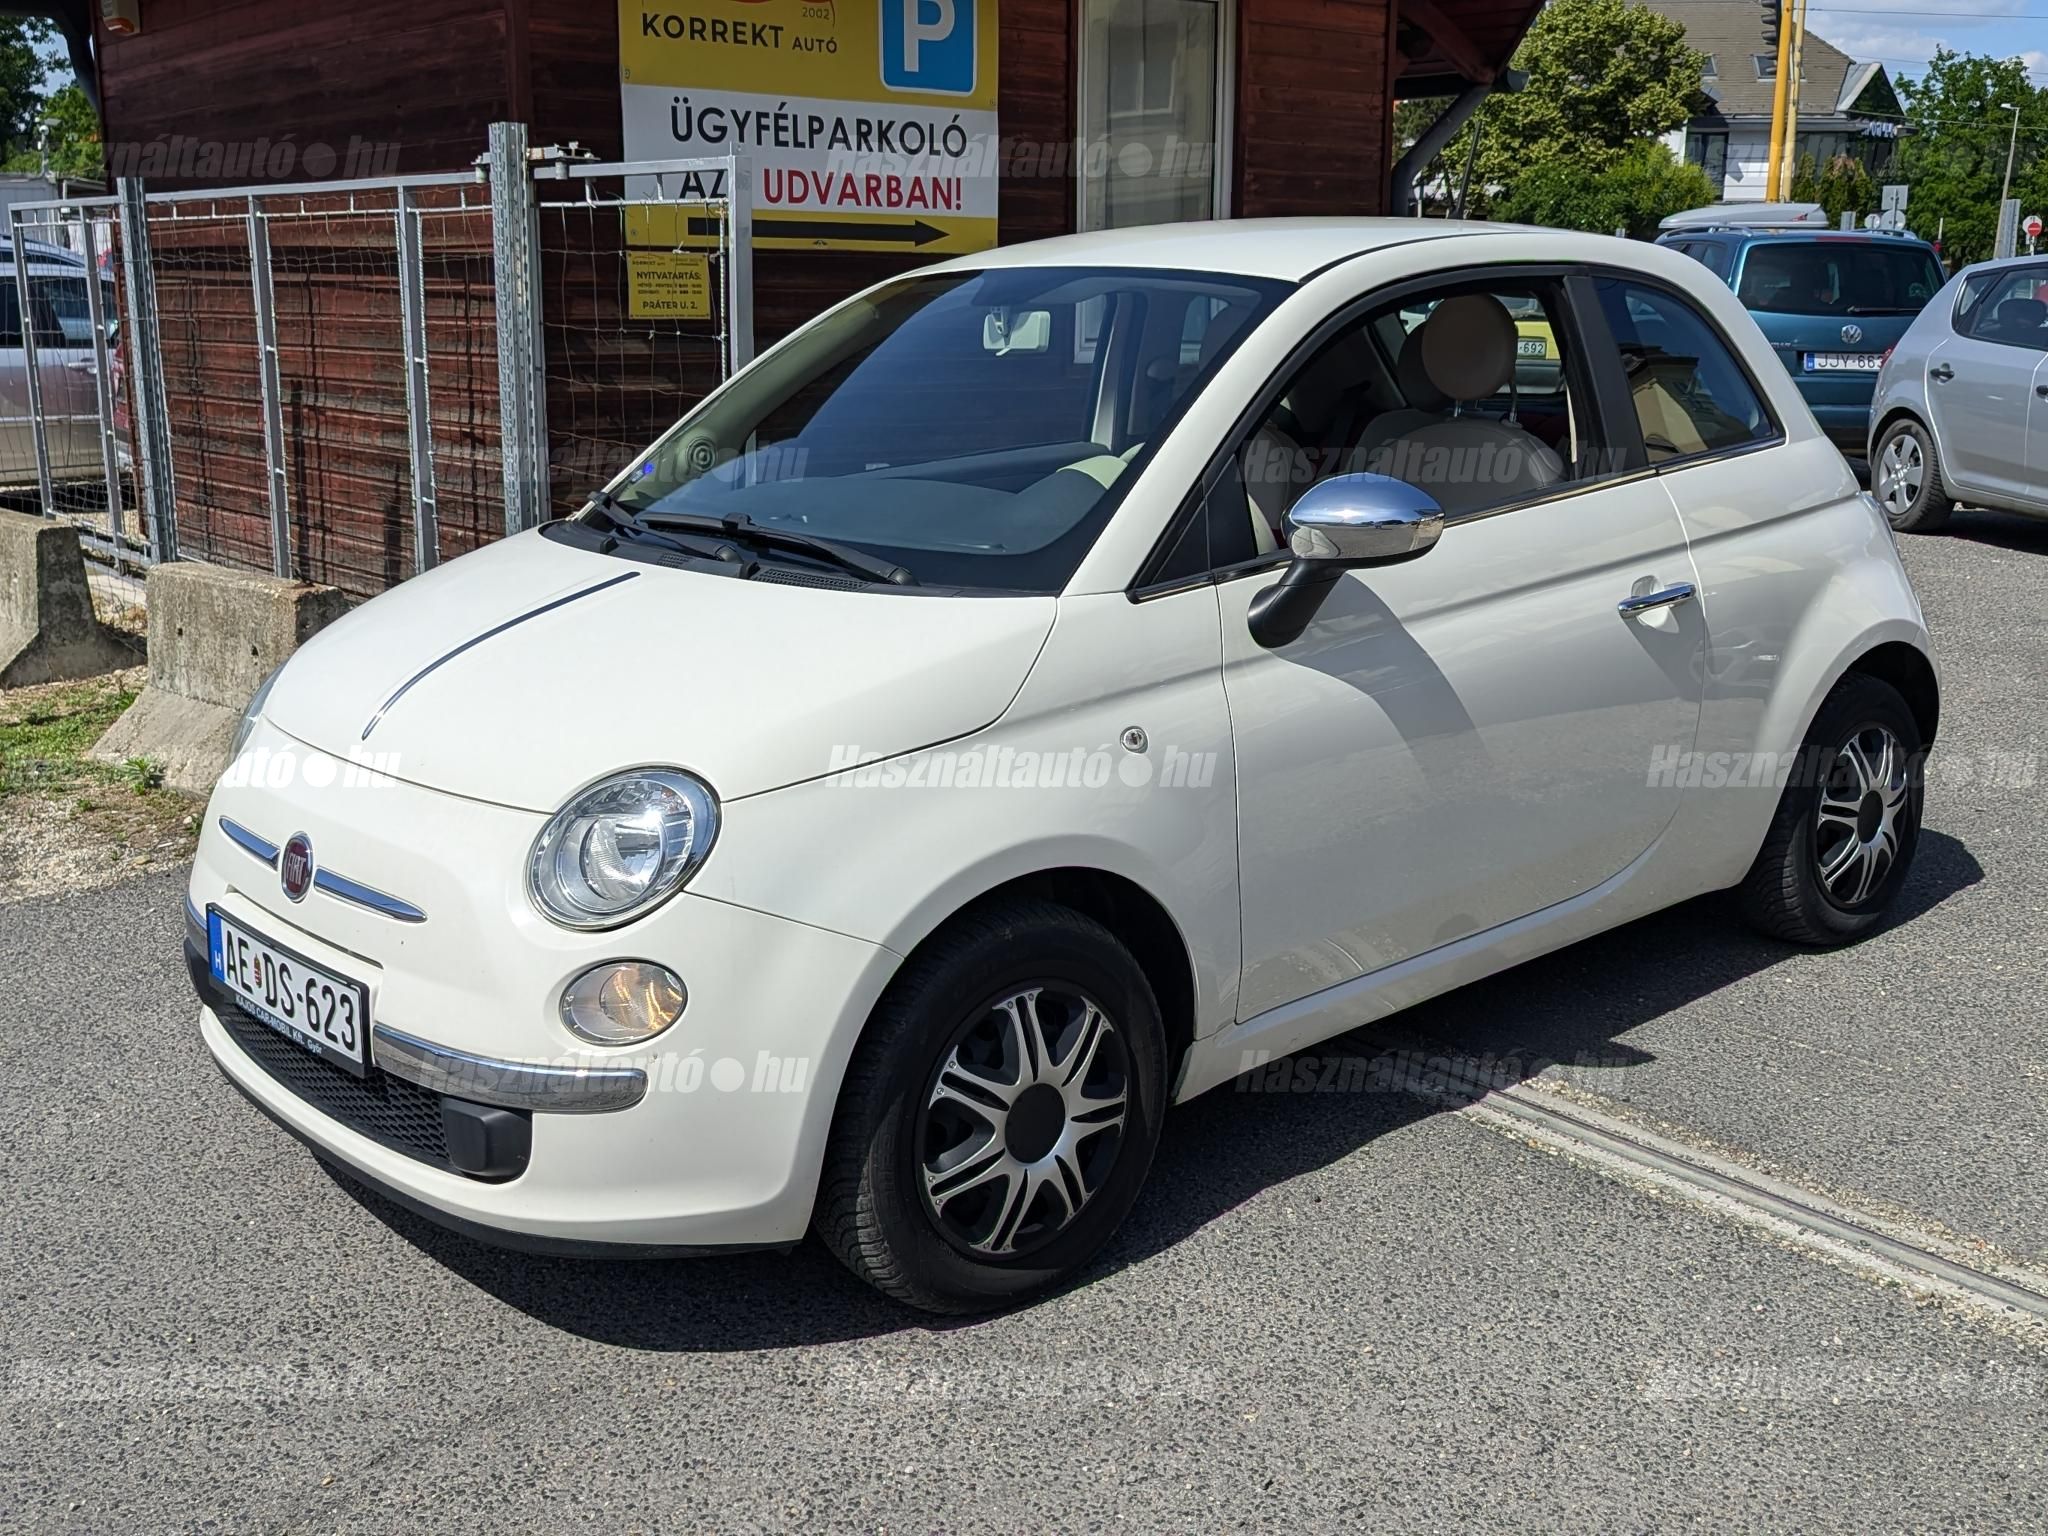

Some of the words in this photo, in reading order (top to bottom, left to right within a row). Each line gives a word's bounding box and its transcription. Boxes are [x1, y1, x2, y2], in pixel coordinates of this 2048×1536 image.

[802, 7, 830, 19] 2002
[642, 12, 784, 48] KORREKT
[792, 37, 838, 53] AUTÓ
[671, 96, 967, 158] ÜGYFÉLPARKOLÓ
[763, 167, 962, 210] UDVARBAN!
[643, 299, 678, 309] PRÁTER
[287, 852, 307, 886] FIAT
[214, 951, 222, 971] H
